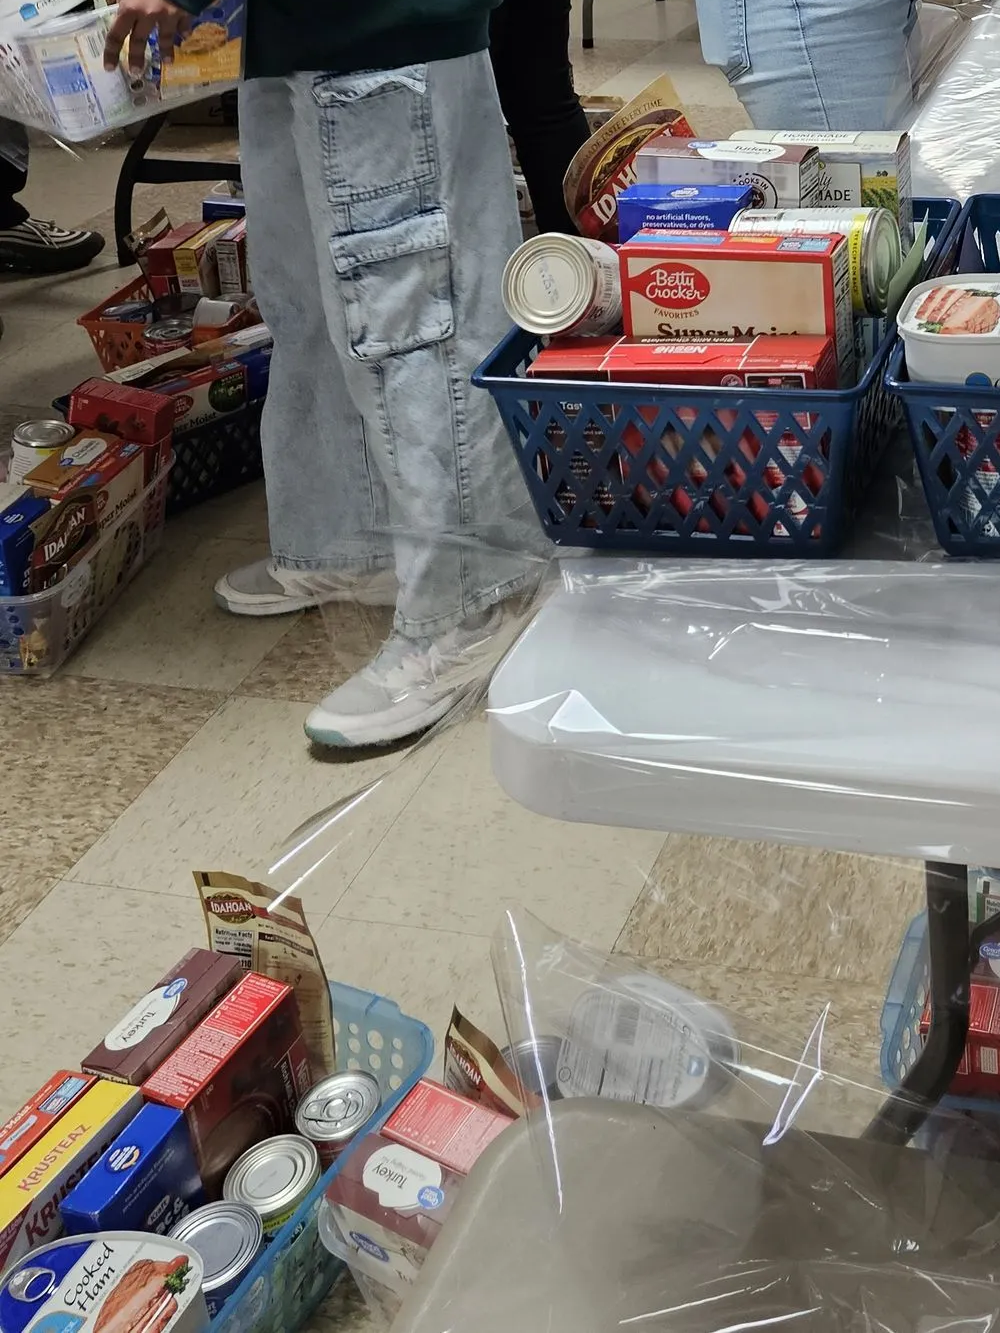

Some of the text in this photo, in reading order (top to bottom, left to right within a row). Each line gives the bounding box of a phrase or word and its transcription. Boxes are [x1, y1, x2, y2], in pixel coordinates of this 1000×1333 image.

[602, 98, 663, 143] TASTE EVERY TIME
[642, 221, 689, 229] preservatives,
[655, 213, 684, 221] artificial
[684, 213, 711, 222] flavors,
[645, 282, 705, 302] Crocker
[651, 268, 695, 292] Betty
[654, 307, 700, 319] FAVORITES
[656, 322, 728, 337] Super
[210, 900, 252, 913] IDAHOAN
[122, 1010, 156, 1043] Turkey
[17, 1123, 92, 1192] KRUSTEAZ
[371, 1163, 408, 1190] Turkey
[63, 1241, 115, 1307] Cooked
[76, 1266, 116, 1312] Ham
